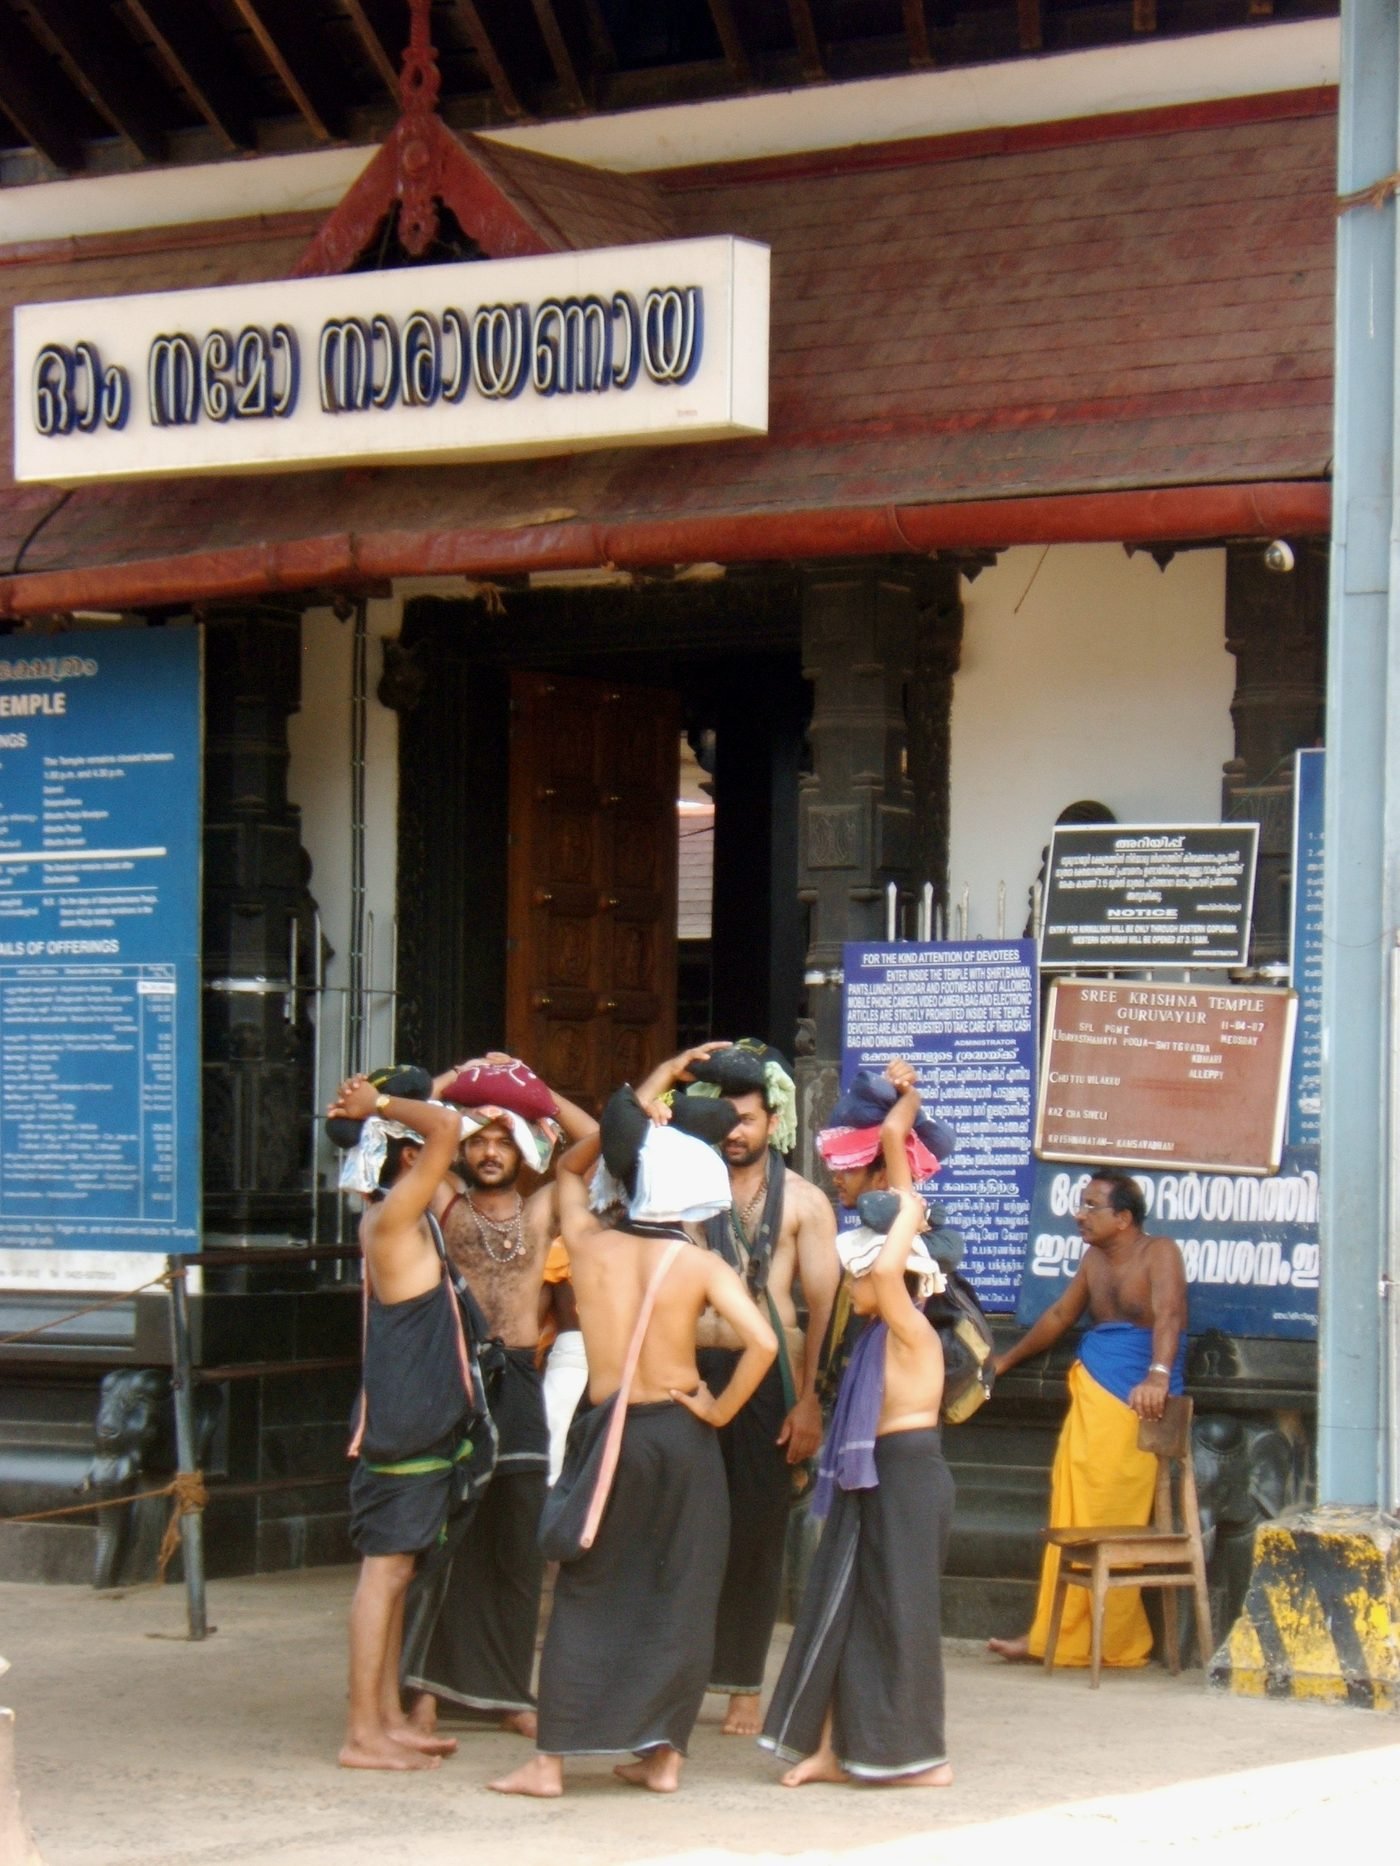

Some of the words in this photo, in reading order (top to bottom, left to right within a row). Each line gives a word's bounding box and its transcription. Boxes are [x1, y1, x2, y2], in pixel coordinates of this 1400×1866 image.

[32, 340, 130, 438] ഓം
[148, 325, 299, 428] നമോ
[319, 284, 704, 414] നാരായണായ
[1114, 836, 1187, 848] അറിയിപ്പ്
[1107, 908, 1179, 917] NOTICE
[47, 938, 120, 954] OFFERINGS
[863, 953, 880, 964] FOR
[881, 952, 897, 964] THE
[898, 952, 918, 964] KIND
[918, 951, 963, 963] ATTENTION
[964, 951, 976, 962] OF
[976, 949, 1020, 961] DEVOTEES
[886, 969, 908, 982] ENTER
[908, 968, 930, 981] INSIDE
[930, 968, 942, 981] THE
[943, 968, 968, 980] TEMPLE
[968, 967, 986, 980] WITH
[940, 981, 976, 994] FOOTWEAR
[977, 980, 984, 993] IS
[984, 980, 999, 993] NOT
[847, 995, 871, 1008] MOBILE
[979, 994, 992, 1006] AND
[993, 992, 1032, 1006] ELECTRONIC
[1080, 989, 1118, 1002] SREE
[1130, 992, 1198, 1008] KRISHNA
[1208, 996, 1265, 1012] TEMPLE
[848, 1008, 879, 1022] ARTICLES
[879, 1008, 894, 1021] ARE
[894, 1008, 925, 1021] STRICTLY
[966, 1007, 988, 1020] INSIDE
[988, 1006, 1002, 1020] THE
[1117, 1007, 1207, 1024] GURUVAYUR
[847, 1022, 878, 1034] DEVOTEES
[878, 1022, 891, 1034] ARE
[891, 1022, 908, 1034] ALSO
[908, 1021, 944, 1034] REQUESTED
[944, 1021, 953, 1034] TO
[968, 1020, 986, 1032] CARE
[986, 1020, 996, 1032] OF
[1014, 1019, 1032, 1032] CASH
[1079, 1022, 1094, 1032] SPL
[847, 1035, 862, 1048] BAG
[862, 1035, 874, 1048] AND
[942, 1178, 1020, 1195] கவனத்திற்கு
